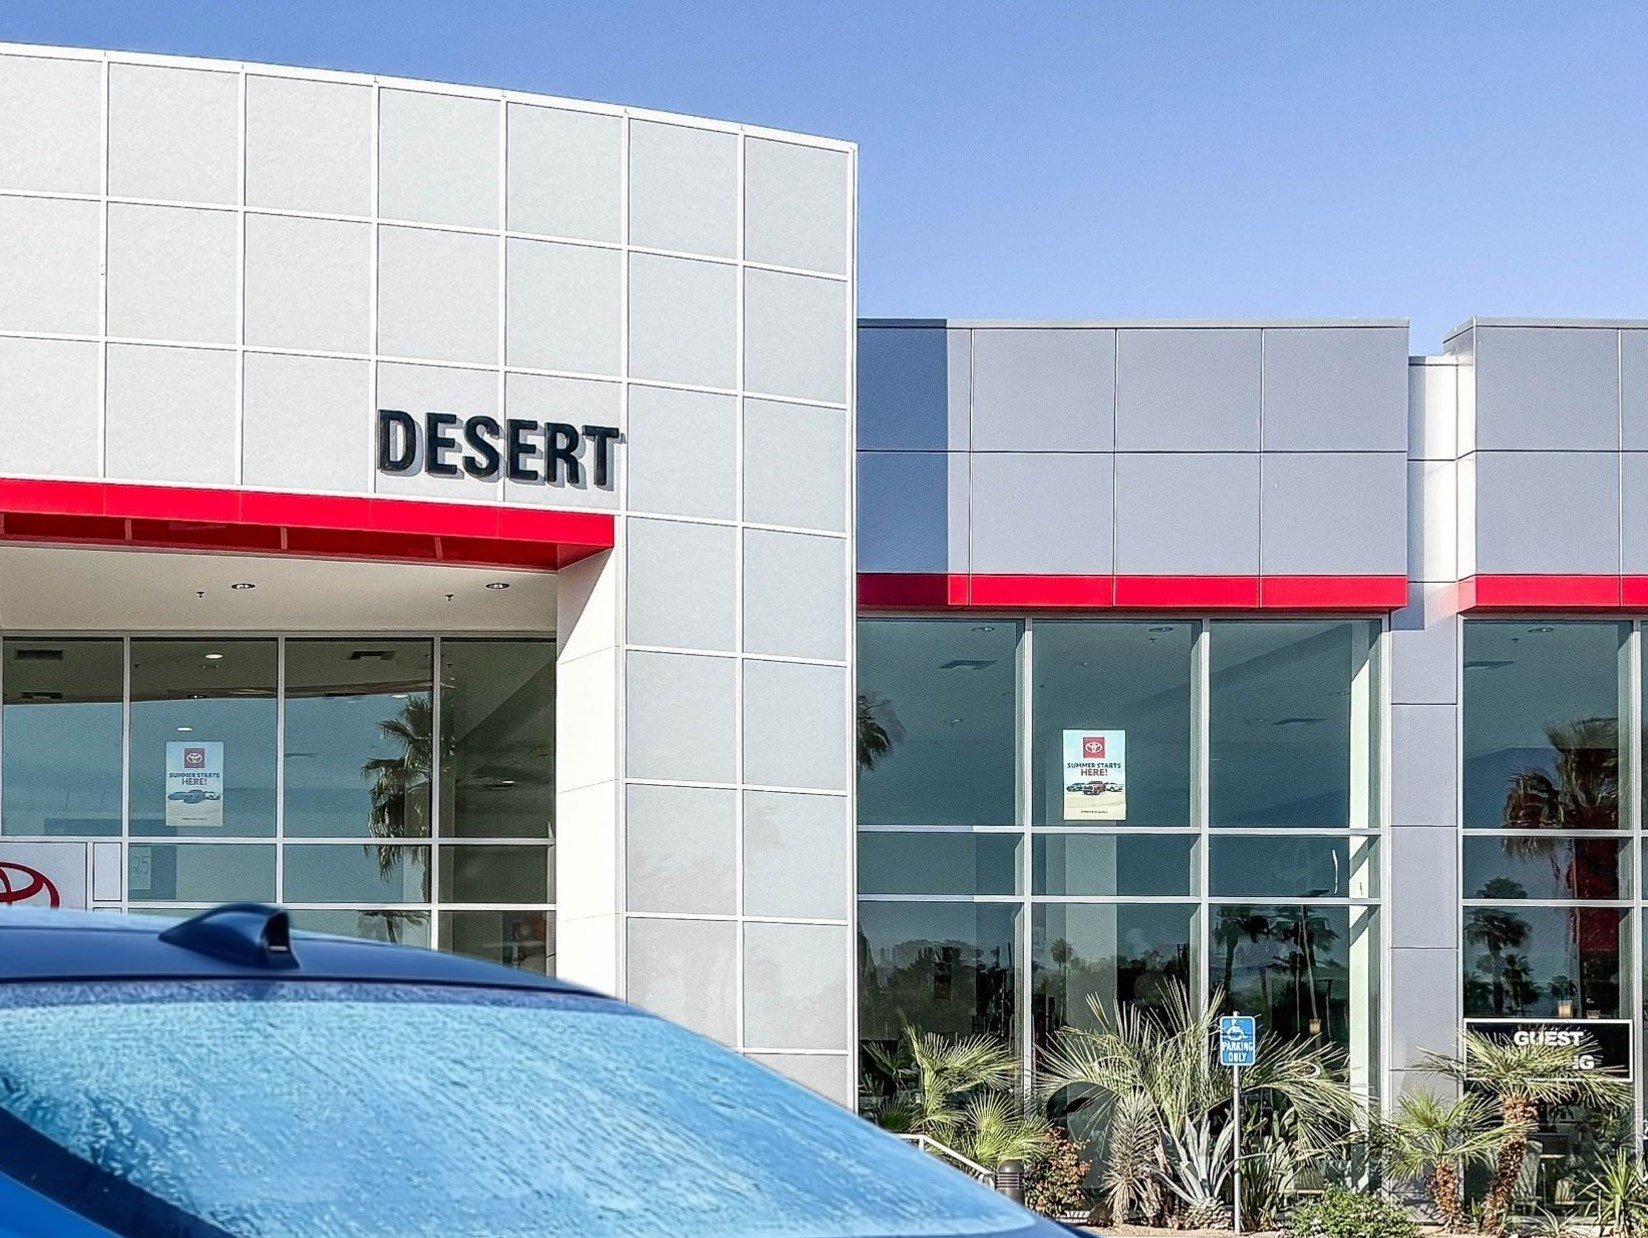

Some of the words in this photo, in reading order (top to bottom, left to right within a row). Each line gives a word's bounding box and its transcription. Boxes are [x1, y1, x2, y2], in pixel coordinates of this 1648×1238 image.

[377, 409, 620, 486] DESERT
[1513, 1030, 1584, 1047] GUEST
[1222, 1040, 1253, 1052] PARKING
[1228, 1051, 1248, 1062] ONLY
